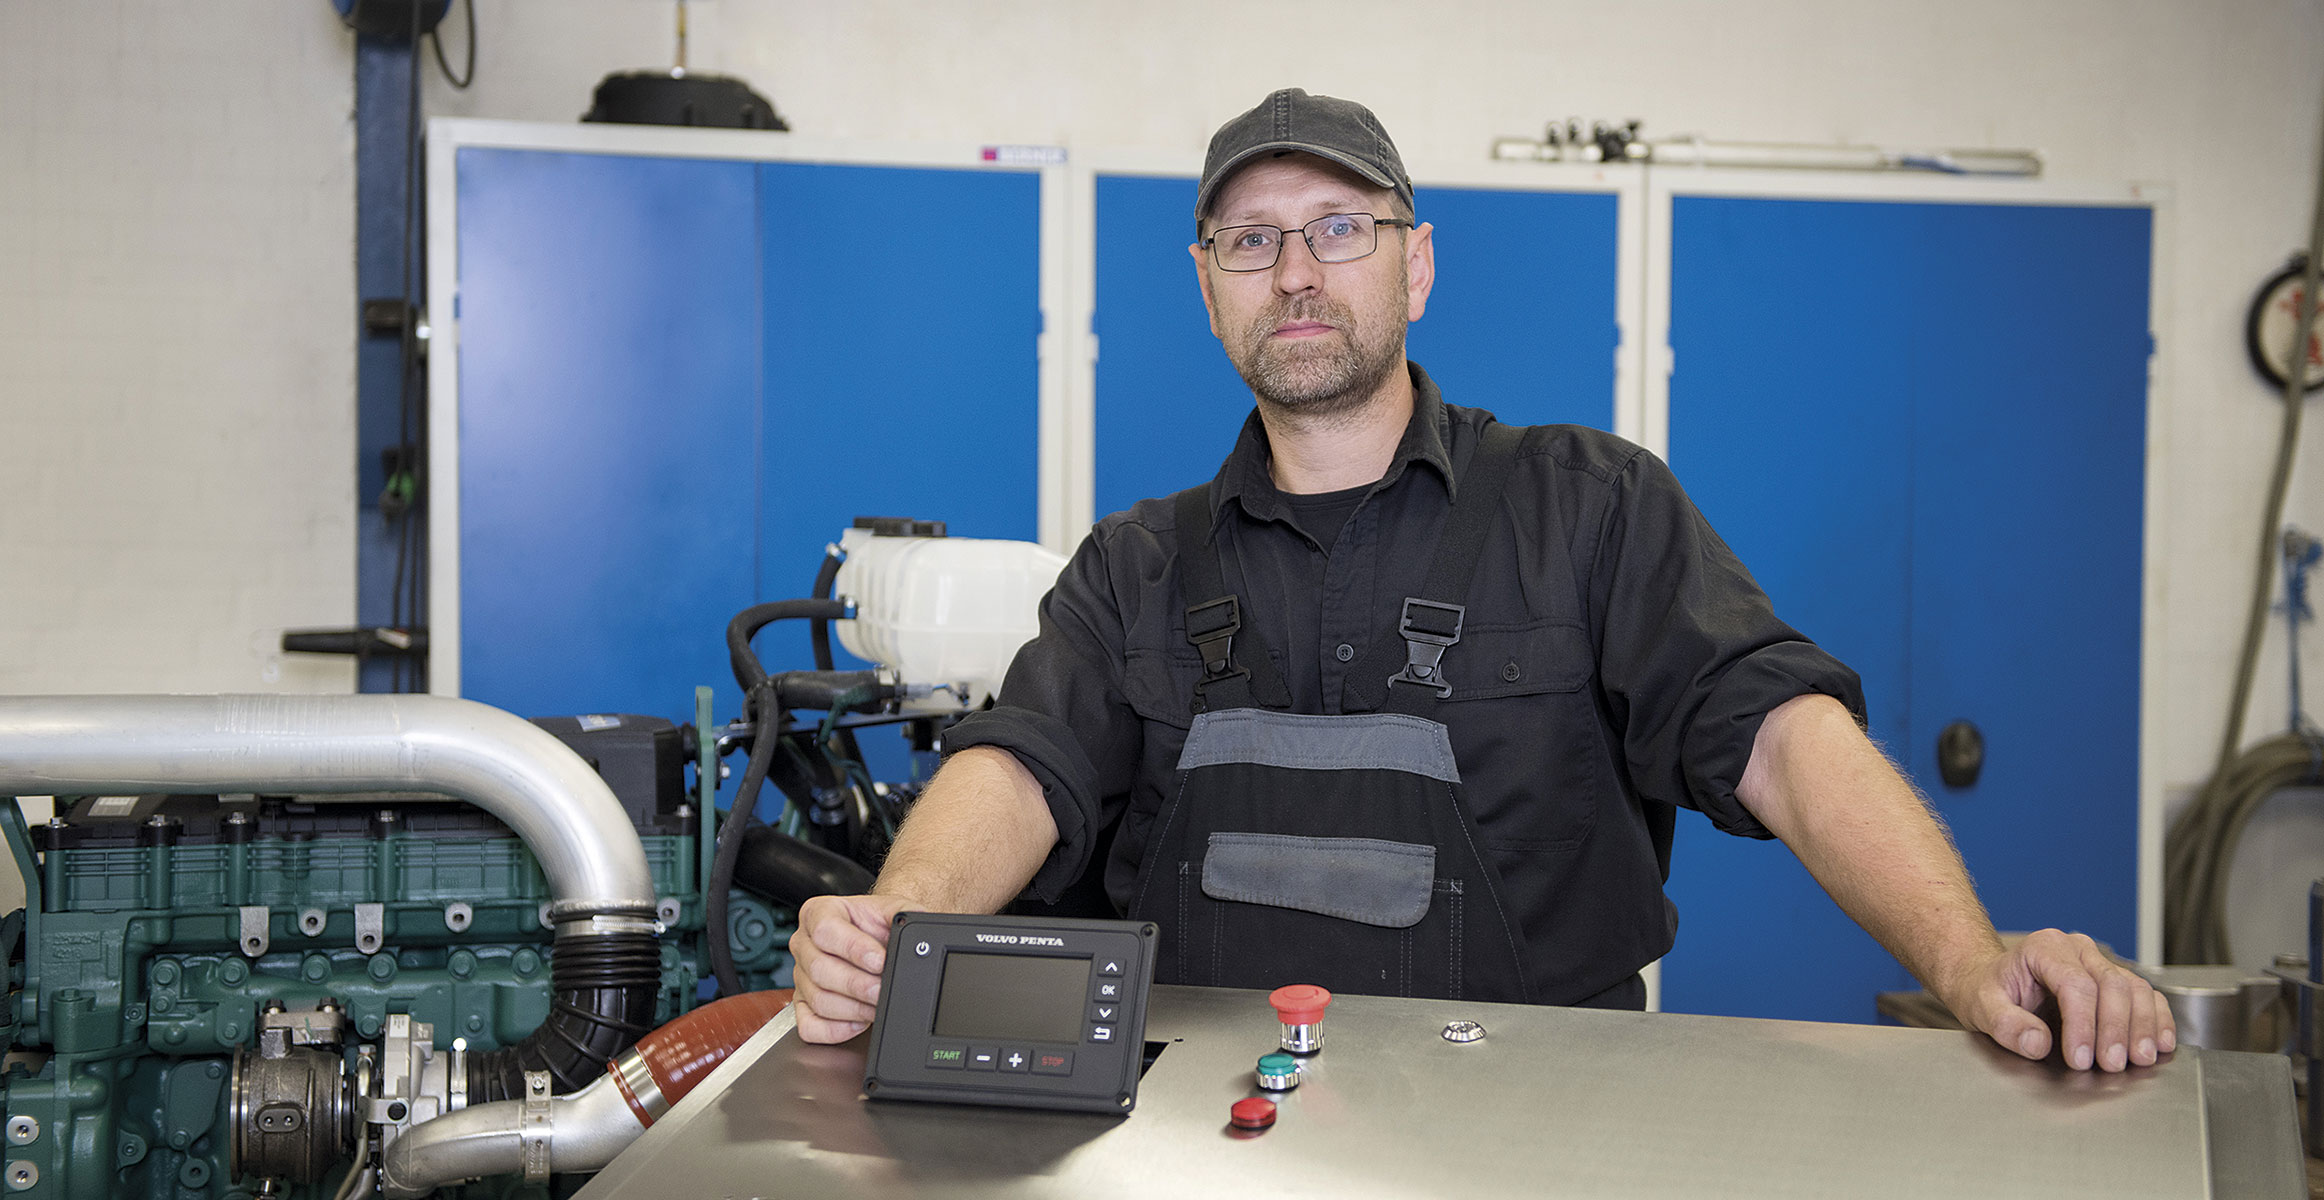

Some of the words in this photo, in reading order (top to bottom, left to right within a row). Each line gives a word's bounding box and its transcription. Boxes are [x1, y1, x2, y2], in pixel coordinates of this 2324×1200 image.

[976, 934, 1018, 944] VOLVO
[1020, 936, 1064, 946] PENTA
[1101, 984, 1115, 995] OK
[933, 1050, 961, 1060] START
[1041, 1056, 1064, 1067] STOP
